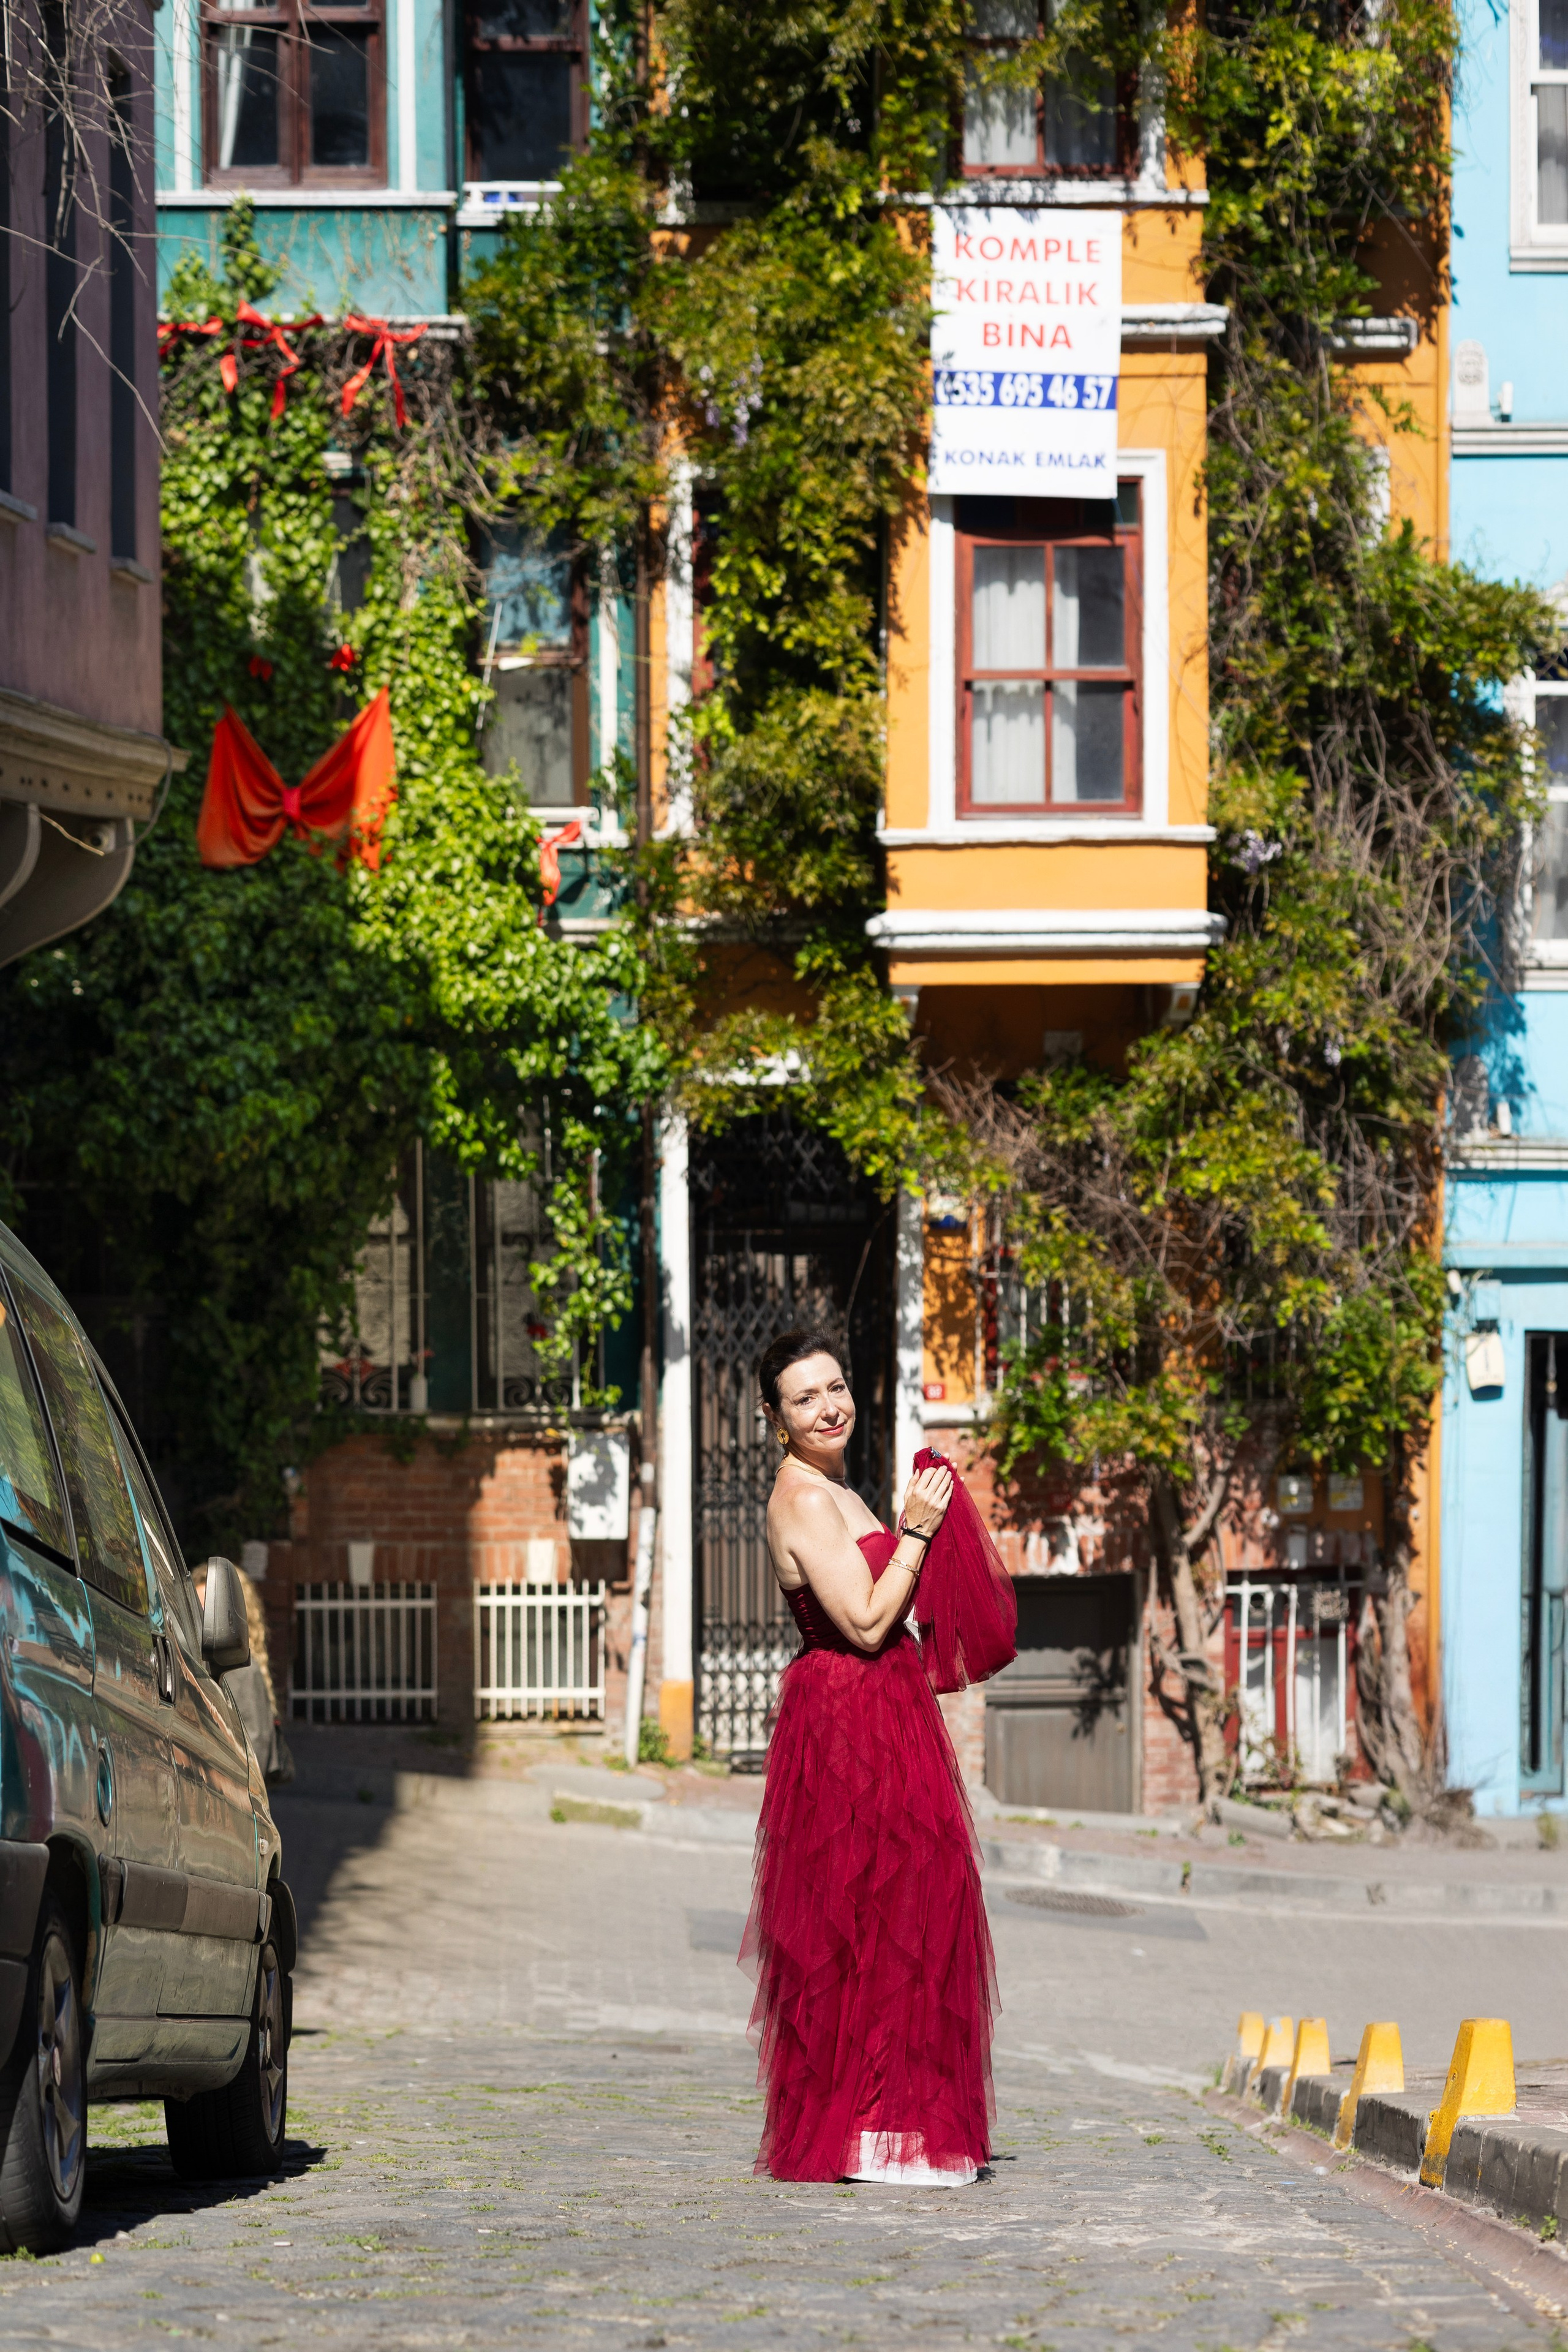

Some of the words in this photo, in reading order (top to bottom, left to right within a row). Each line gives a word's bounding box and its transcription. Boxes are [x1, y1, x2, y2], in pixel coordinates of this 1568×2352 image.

[954, 233, 1101, 263] KOMPLE
[983, 314, 1072, 349] BİNA
[999, 372, 1044, 407] 695
[1047, 374, 1079, 409] 46
[1082, 375, 1114, 410] 57
[944, 450, 1025, 466] KONAK
[1035, 451, 1106, 469] EMLAK
